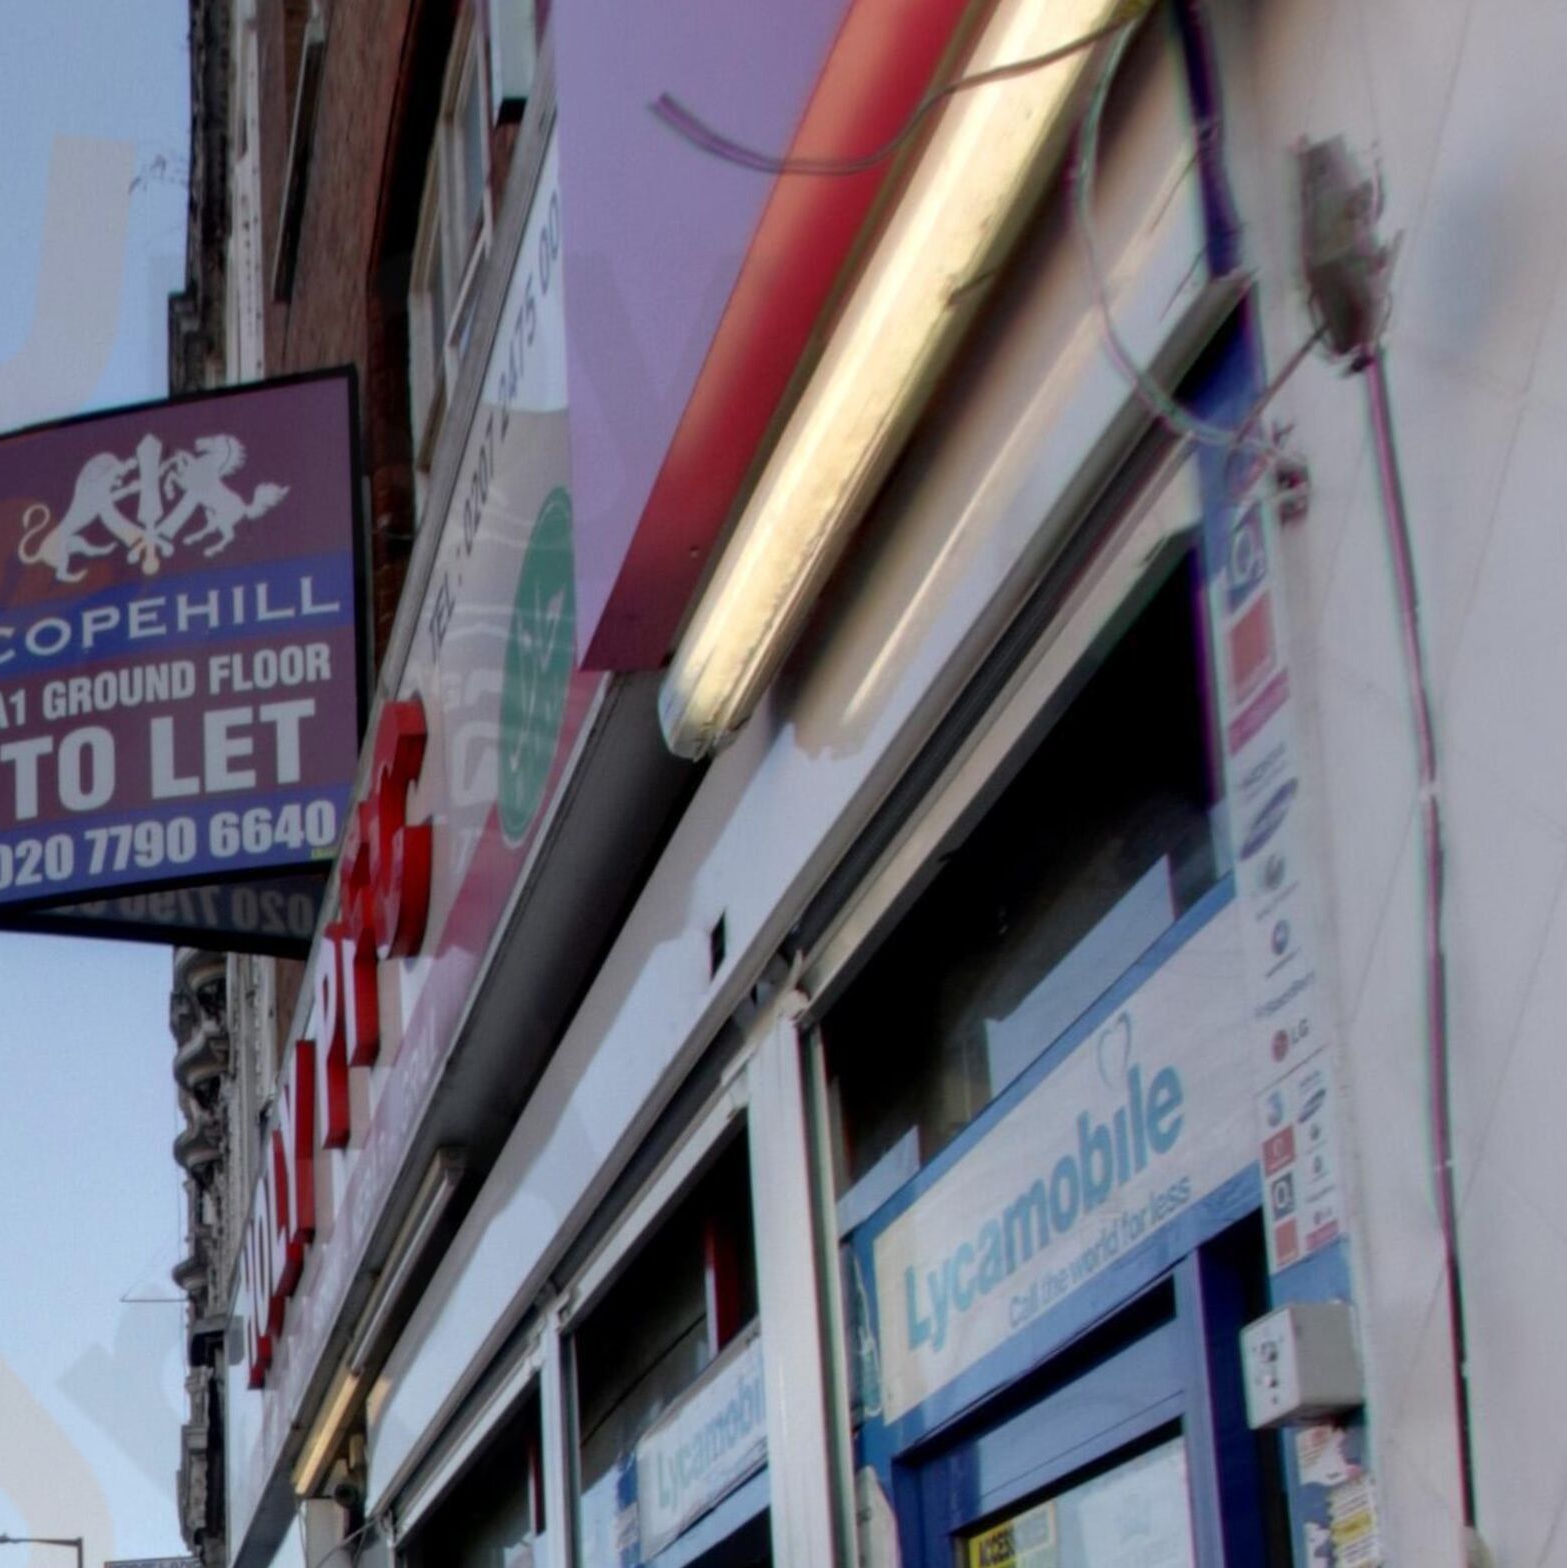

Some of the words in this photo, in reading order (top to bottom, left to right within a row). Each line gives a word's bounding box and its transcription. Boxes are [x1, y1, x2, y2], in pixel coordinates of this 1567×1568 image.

[42, 661, 197, 721] GROUND
[209, 642, 332, 696] FLOOR
[0, 725, 117, 821] TO
[150, 698, 316, 800] LET
[84, 816, 197, 875] 7790
[209, 799, 337, 859] 6640
[904, 1063, 1187, 1355] Lycamobile
